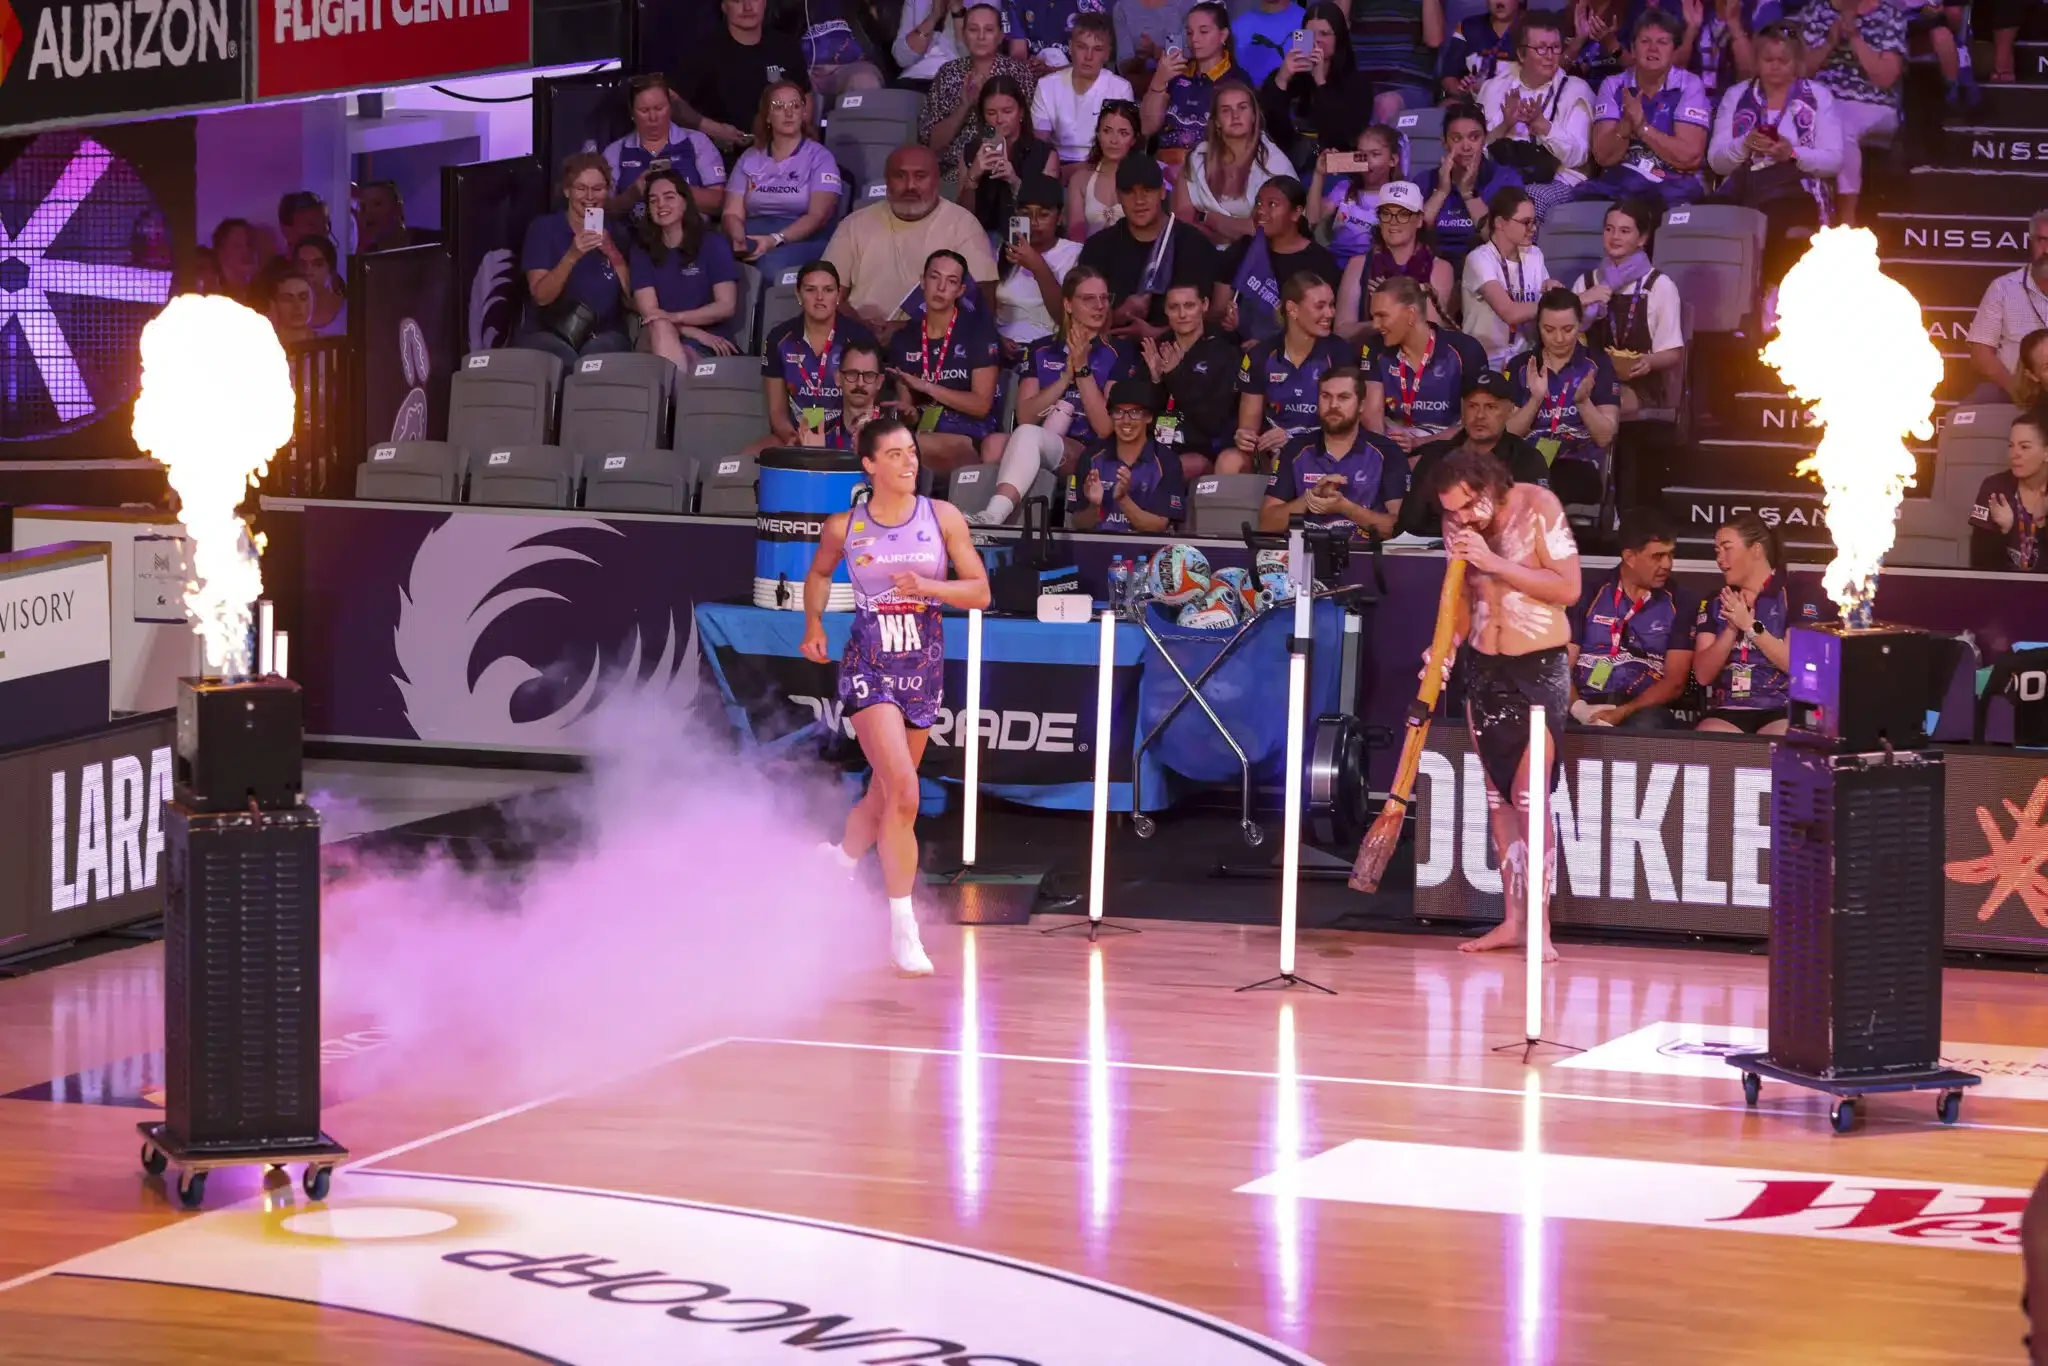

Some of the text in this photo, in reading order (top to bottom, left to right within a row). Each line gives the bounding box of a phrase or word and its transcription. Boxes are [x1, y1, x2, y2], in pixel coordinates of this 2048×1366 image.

[274, 0, 382, 44] FLIGHT
[28, 0, 229, 80] AURIZON
[755, 185, 800, 194] AURIZON
[799, 385, 843, 397] AUIZO
[876, 552, 937, 564] AURIZON
[877, 613, 922, 653] WA
[852, 673, 870, 700] 5
[898, 675, 924, 691] UQ
[51, 744, 175, 912] LARA
